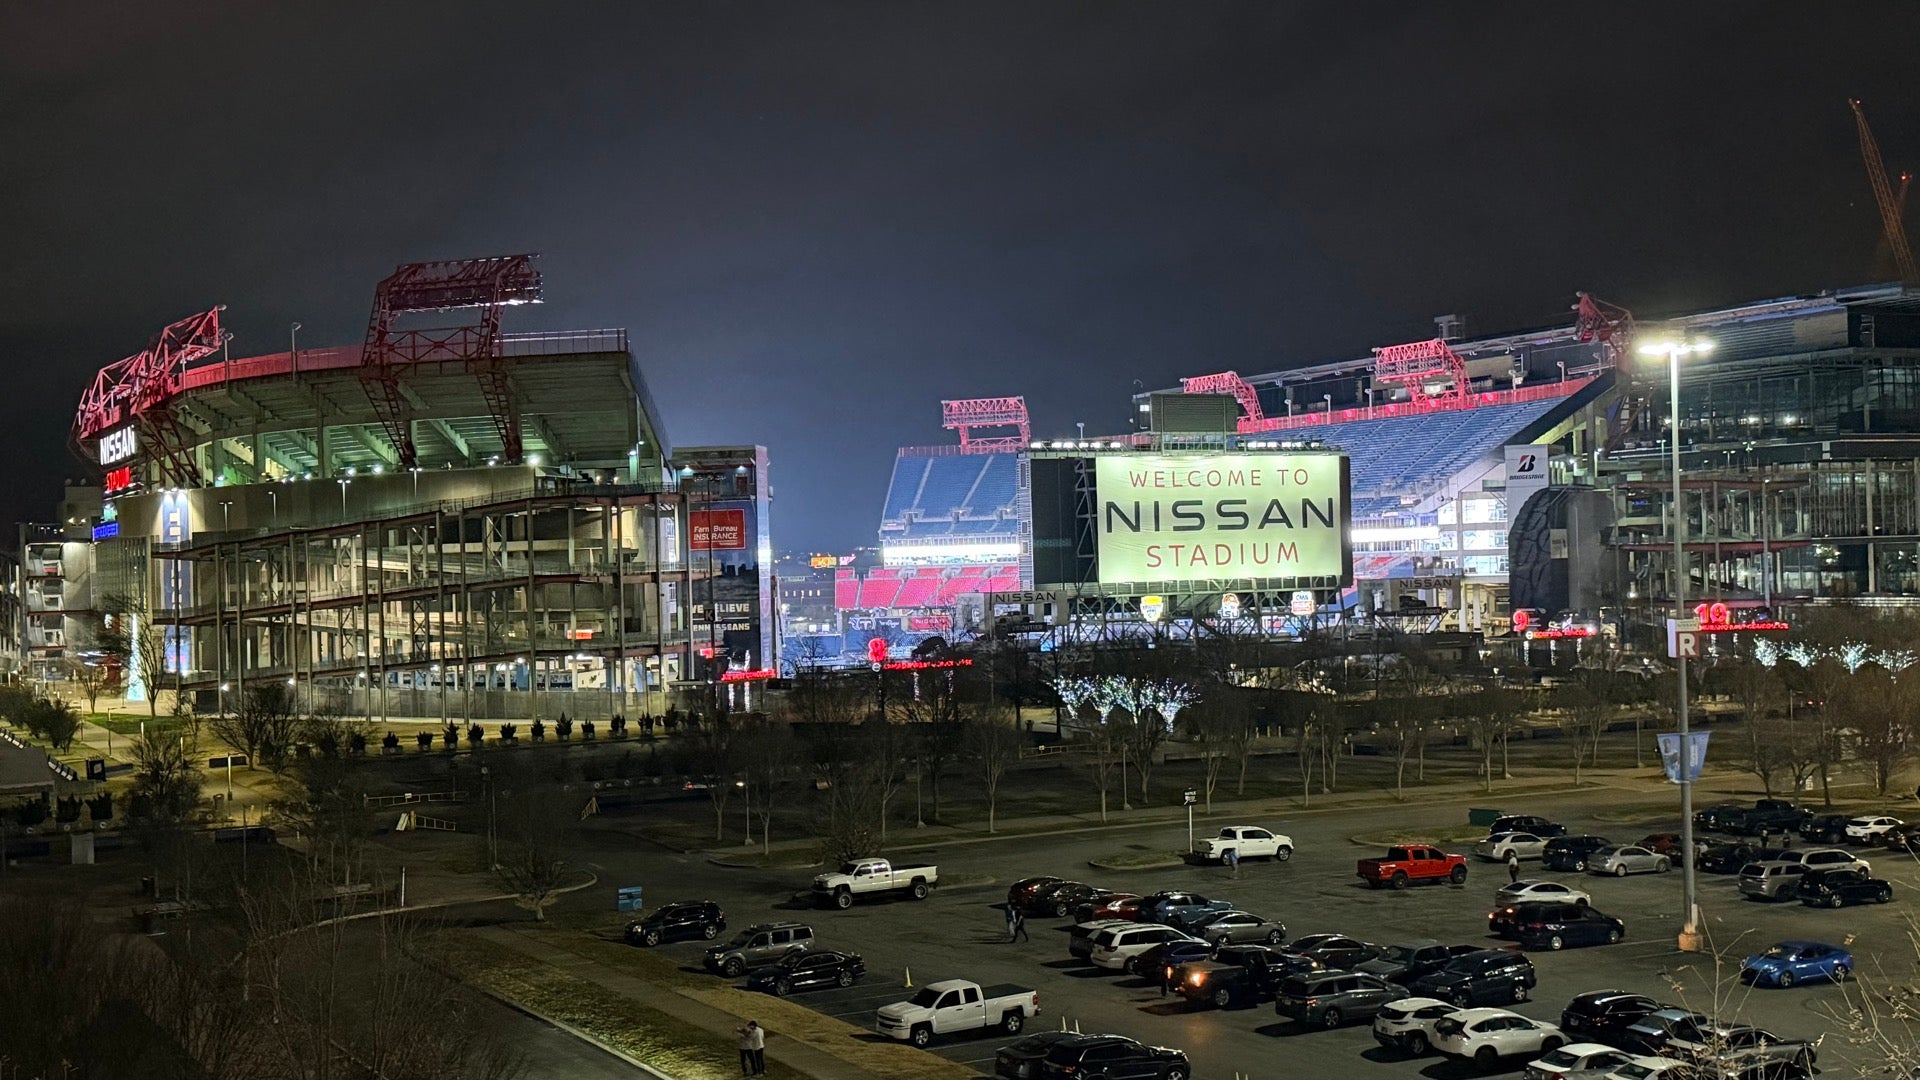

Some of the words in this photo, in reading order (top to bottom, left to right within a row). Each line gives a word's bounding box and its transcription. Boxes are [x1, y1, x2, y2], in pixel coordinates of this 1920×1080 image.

[100, 427, 136, 466] NISSAN
[1129, 469, 1262, 488] WELCOME
[1277, 468, 1309, 486] TO
[1105, 497, 1334, 533] NISSAN
[1146, 541, 1299, 568] STADIUM
[1399, 579, 1451, 589] NISSAN
[995, 591, 1056, 602] NISSAN
[1513, 610, 1529, 632] 9
[868, 637, 887, 663] 8
[1680, 632, 1696, 656] R
